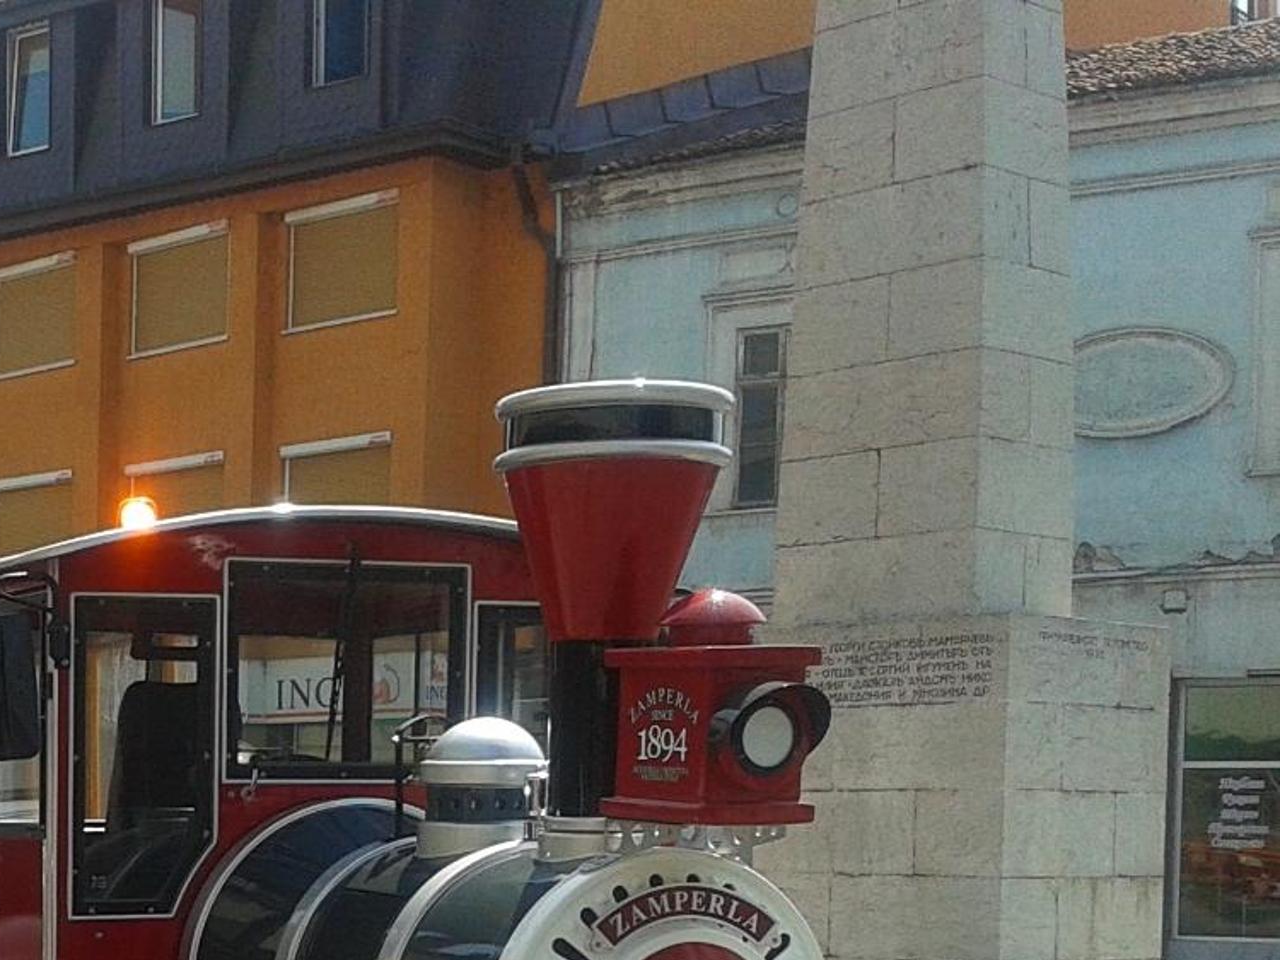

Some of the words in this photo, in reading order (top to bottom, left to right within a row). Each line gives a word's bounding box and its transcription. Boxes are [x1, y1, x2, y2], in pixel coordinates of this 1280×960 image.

[629, 687, 699, 725] ZAMPERLA
[637, 724, 688, 763] 1894
[609, 888, 763, 937] ZAMPERLA
